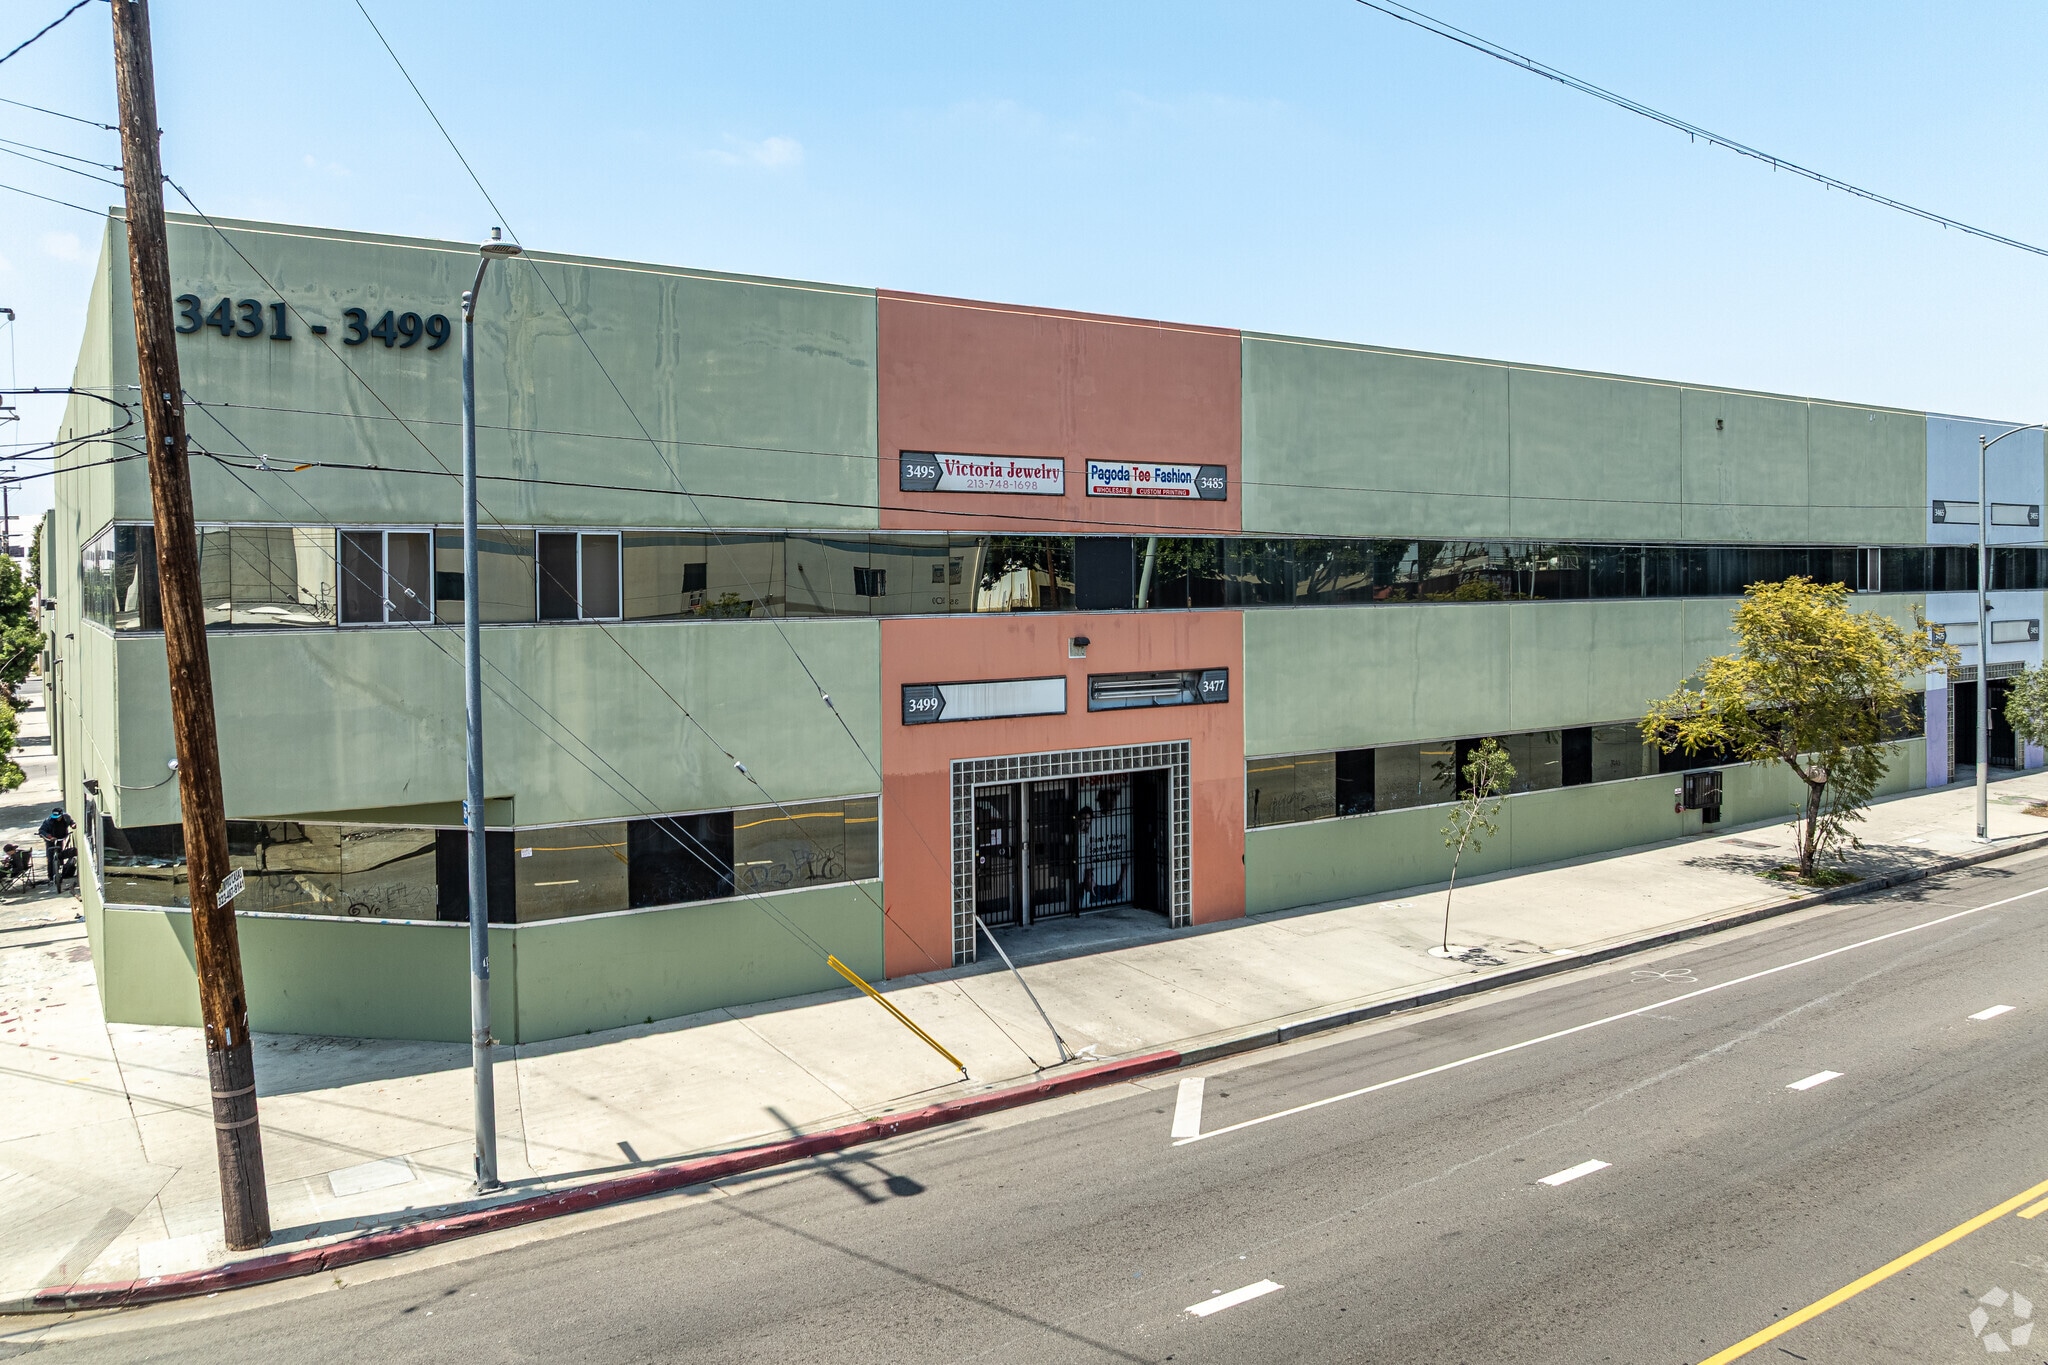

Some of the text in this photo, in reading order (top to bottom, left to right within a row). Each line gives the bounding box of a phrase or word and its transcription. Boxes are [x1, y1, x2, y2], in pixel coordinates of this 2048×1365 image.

[176, 294, 292, 341] 3431
[344, 307, 451, 350] 3499
[906, 464, 936, 479] 3495
[945, 459, 1060, 483] Victoria Jewelry
[1091, 465, 1192, 485] Pagoda Tee Fashion
[967, 479, 1038, 491] 213-748-1698
[1200, 477, 1224, 489] 3485
[1203, 680, 1225, 692] 3477
[909, 697, 939, 712] 3499
